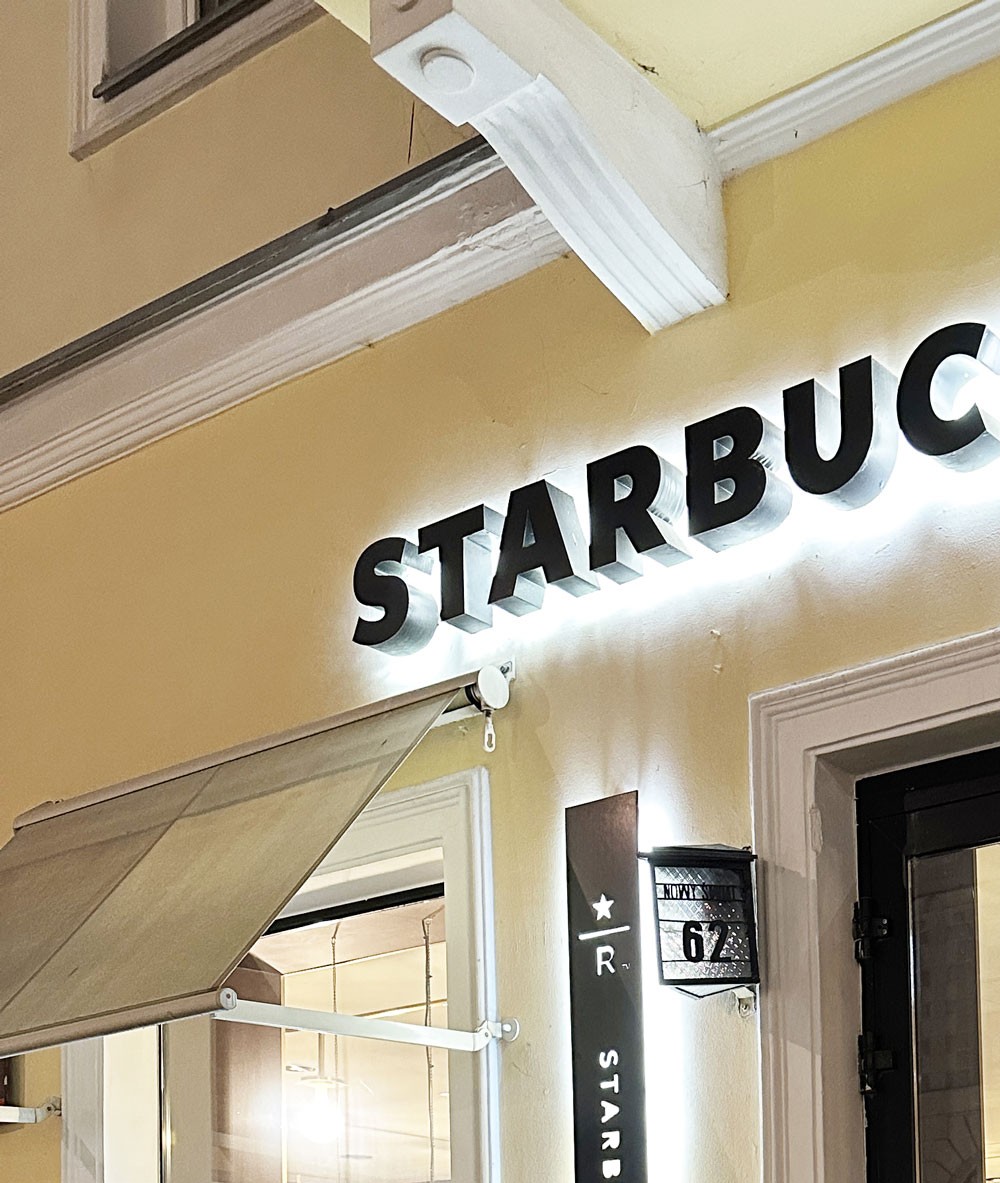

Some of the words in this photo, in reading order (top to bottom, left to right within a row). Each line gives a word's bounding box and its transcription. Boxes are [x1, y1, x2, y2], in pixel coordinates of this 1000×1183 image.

[663, 884, 696, 900] NOWY
[683, 920, 731, 963] 62
[596, 945, 616, 976] R
